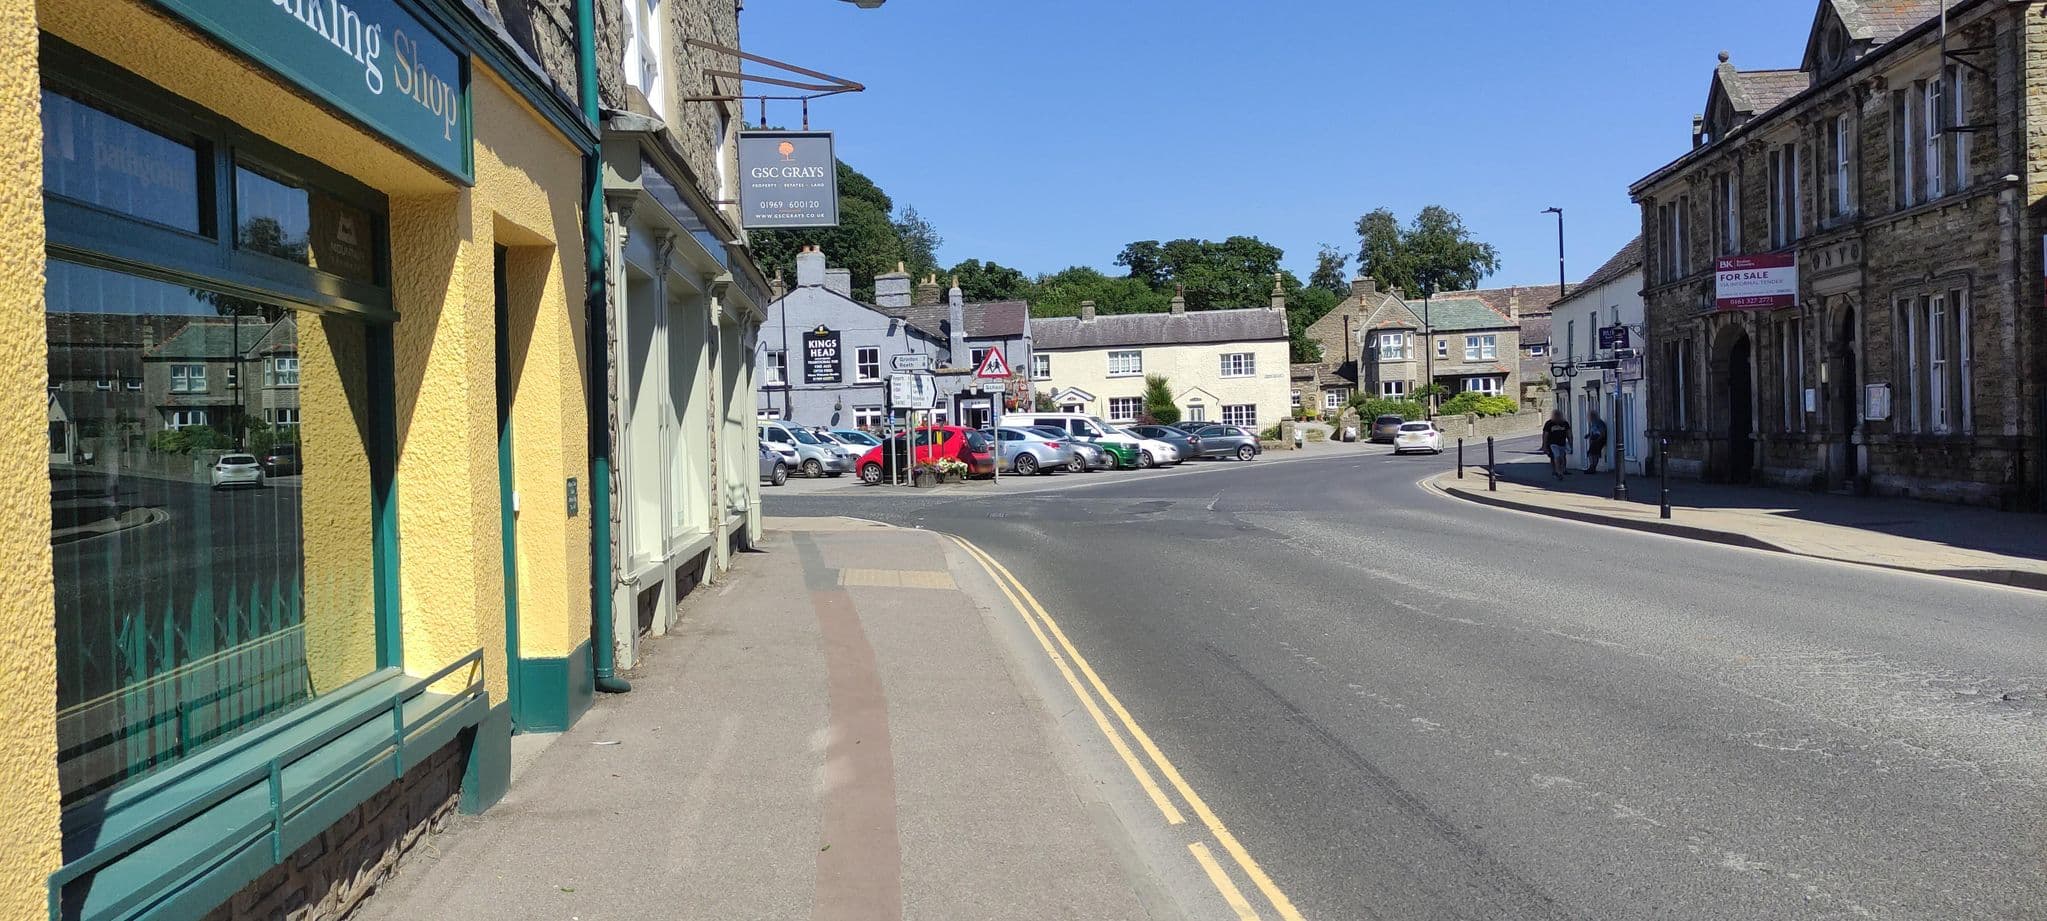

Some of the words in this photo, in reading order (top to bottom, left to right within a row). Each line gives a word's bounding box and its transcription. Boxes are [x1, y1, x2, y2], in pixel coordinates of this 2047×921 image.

[394, 28, 458, 141] Shop
[751, 167, 779, 178] GSC
[782, 166, 824, 178] GRAYS
[760, 201, 783, 209] 01969
[789, 200, 820, 209] 600120
[1744, 271, 1769, 280] SALE
[808, 340, 836, 348] KINGS
[810, 348, 835, 357] HEAD
